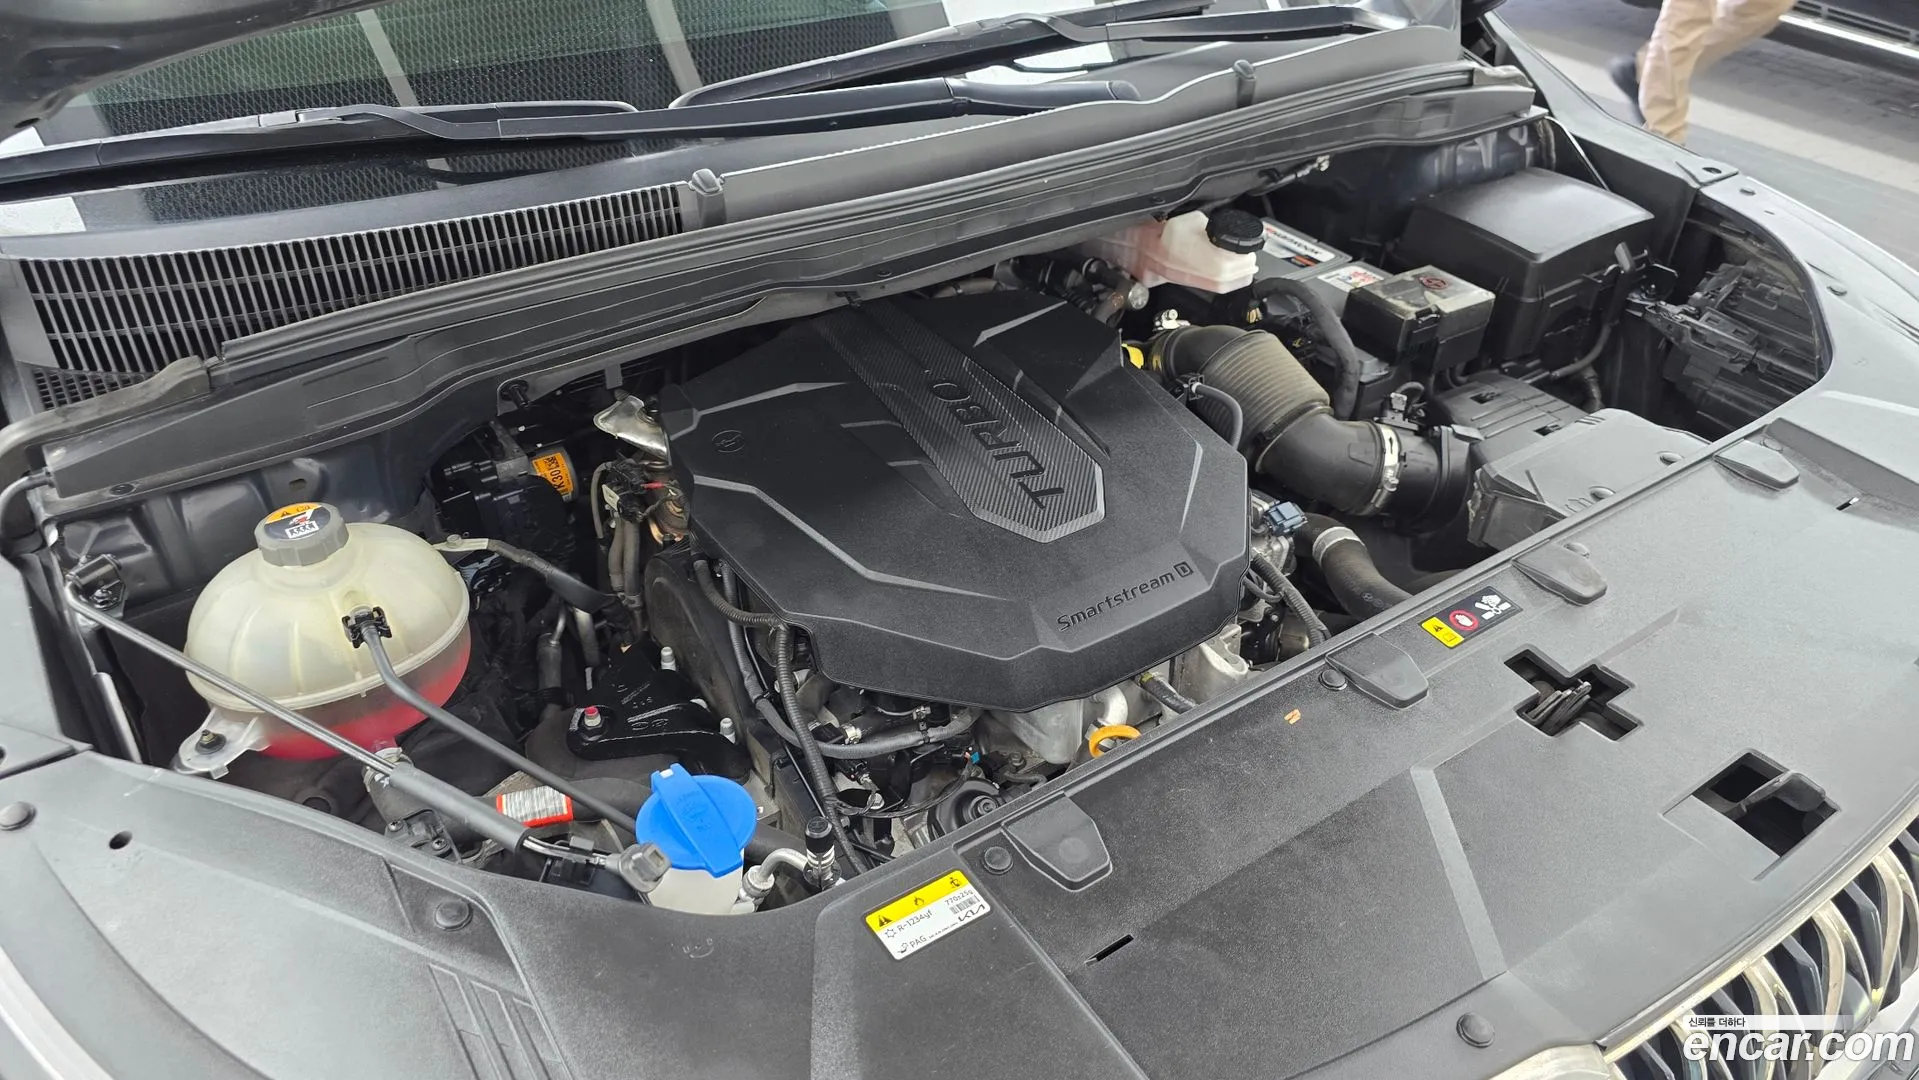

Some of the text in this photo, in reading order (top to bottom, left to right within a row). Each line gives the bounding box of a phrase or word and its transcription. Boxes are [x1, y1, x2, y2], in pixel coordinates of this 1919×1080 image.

[928, 381, 1064, 510] TURBO
[1057, 571, 1176, 631] Smartstream
[896, 908, 933, 933] R-1234yf
[909, 935, 927, 949] PAG
